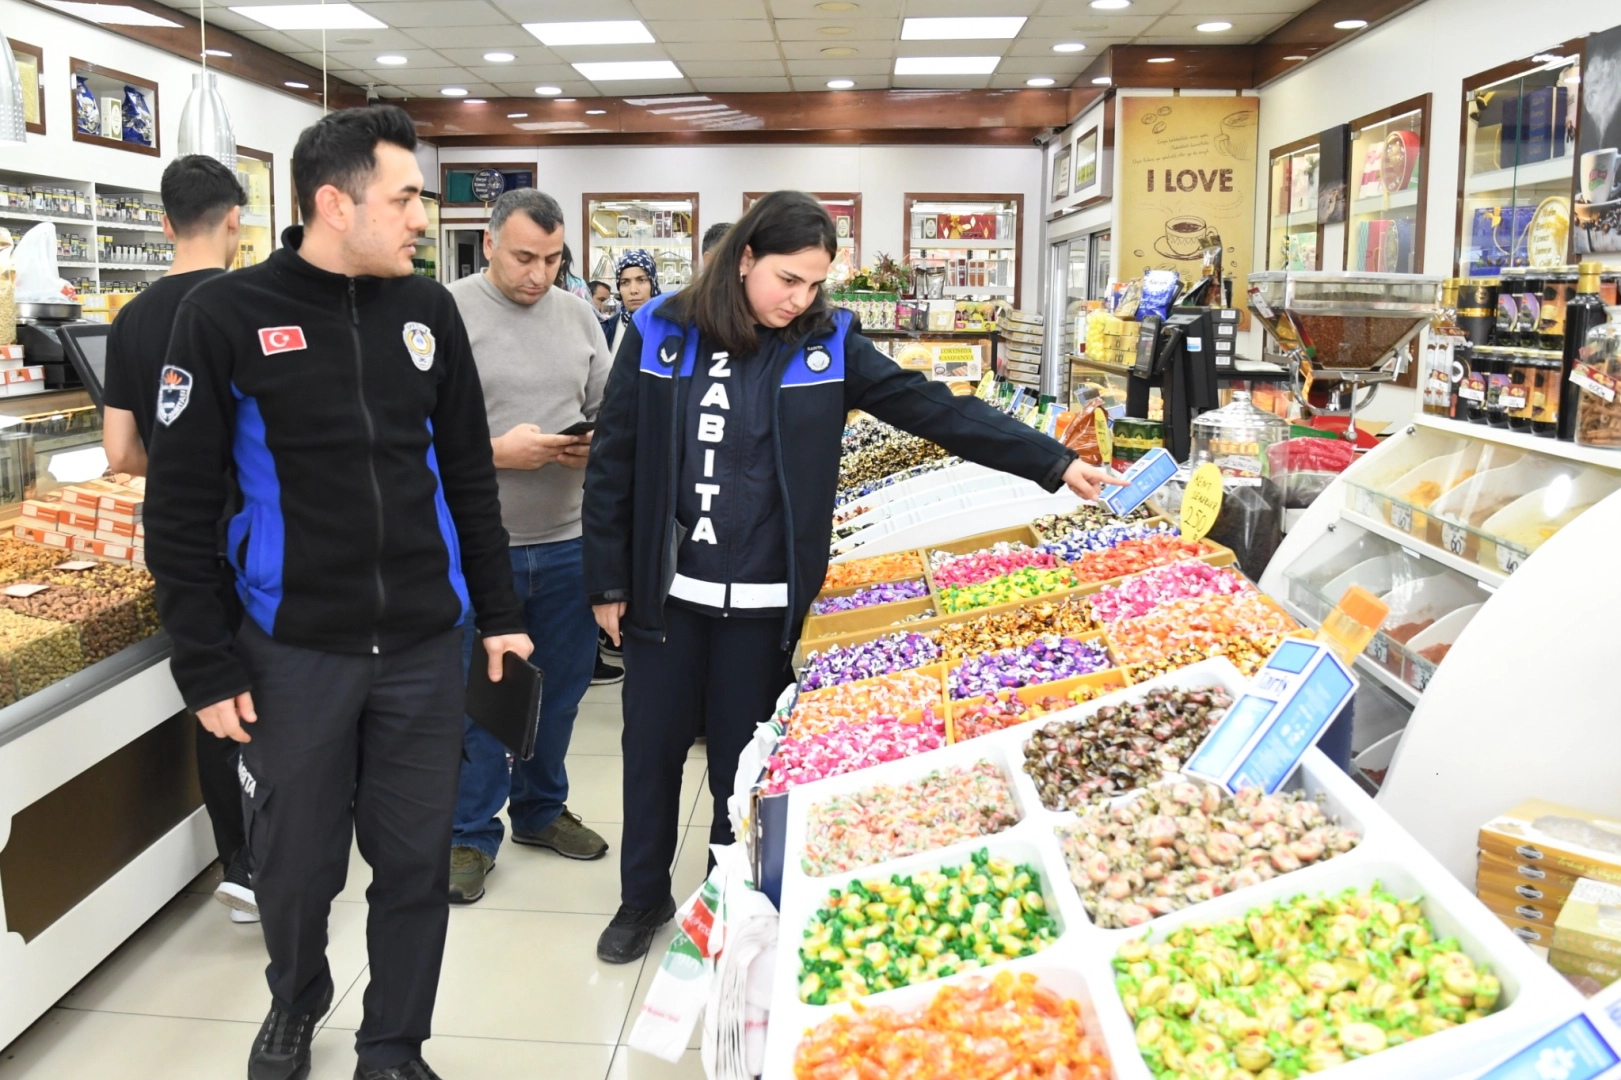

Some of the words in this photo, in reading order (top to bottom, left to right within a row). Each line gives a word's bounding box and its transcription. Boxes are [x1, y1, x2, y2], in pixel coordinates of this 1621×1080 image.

[1147, 168, 1155, 193] I
[1165, 168, 1233, 193] LOVE
[691, 351, 731, 545] ZABITA
[1184, 506, 1206, 532] 250
